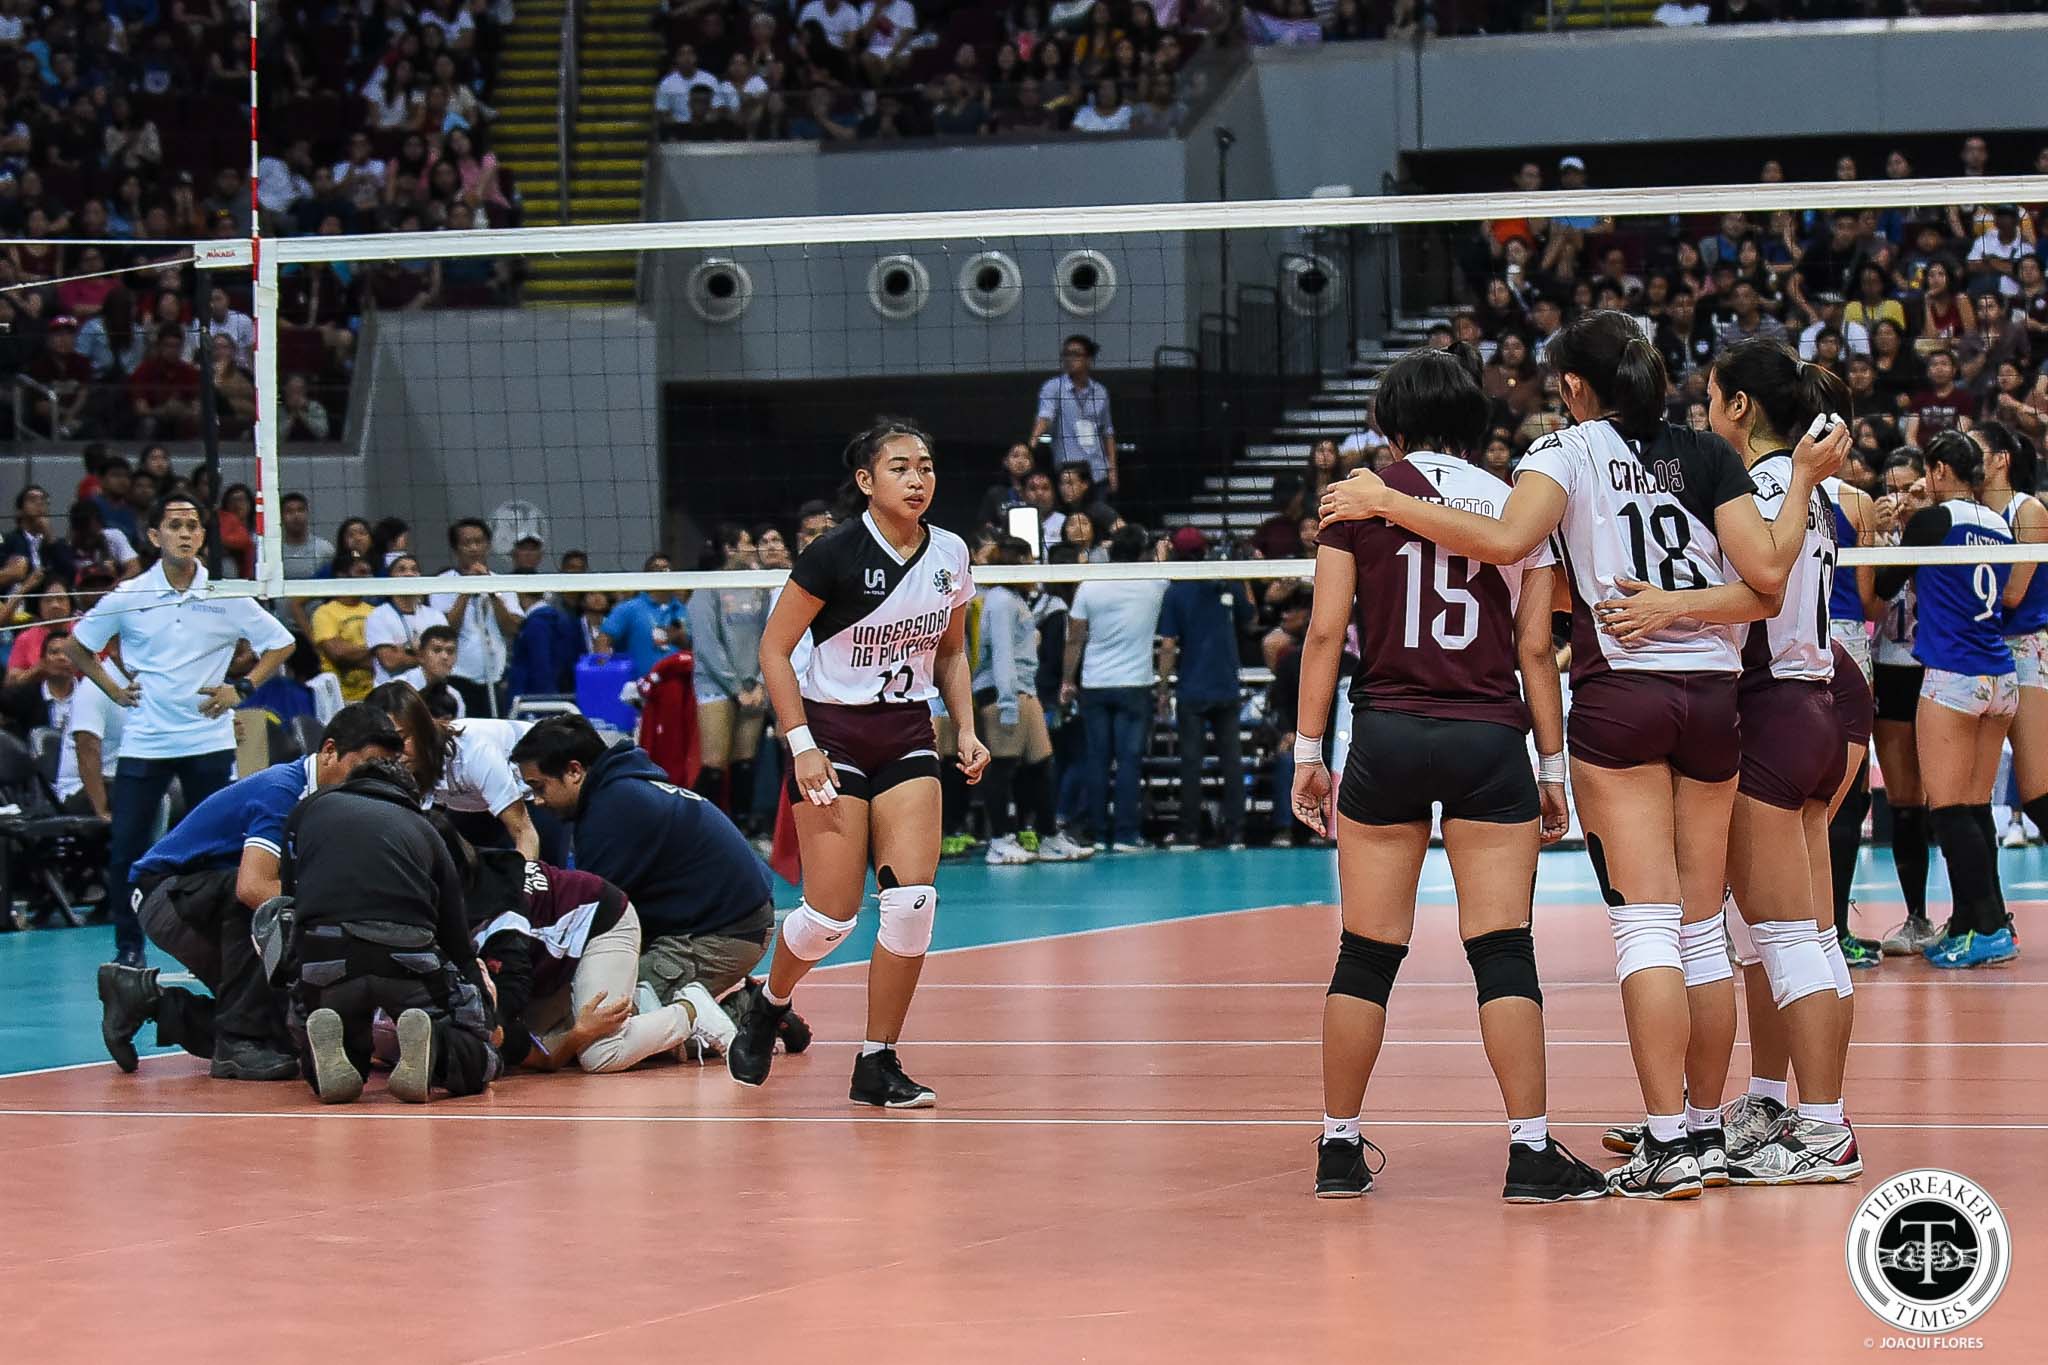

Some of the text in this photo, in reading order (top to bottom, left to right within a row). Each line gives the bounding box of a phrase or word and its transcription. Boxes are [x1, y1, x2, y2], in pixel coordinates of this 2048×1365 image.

[1617, 501, 1709, 591] 18
[1396, 541, 1481, 650] 15
[1973, 563, 1998, 622] 9
[851, 646, 874, 668] NG
